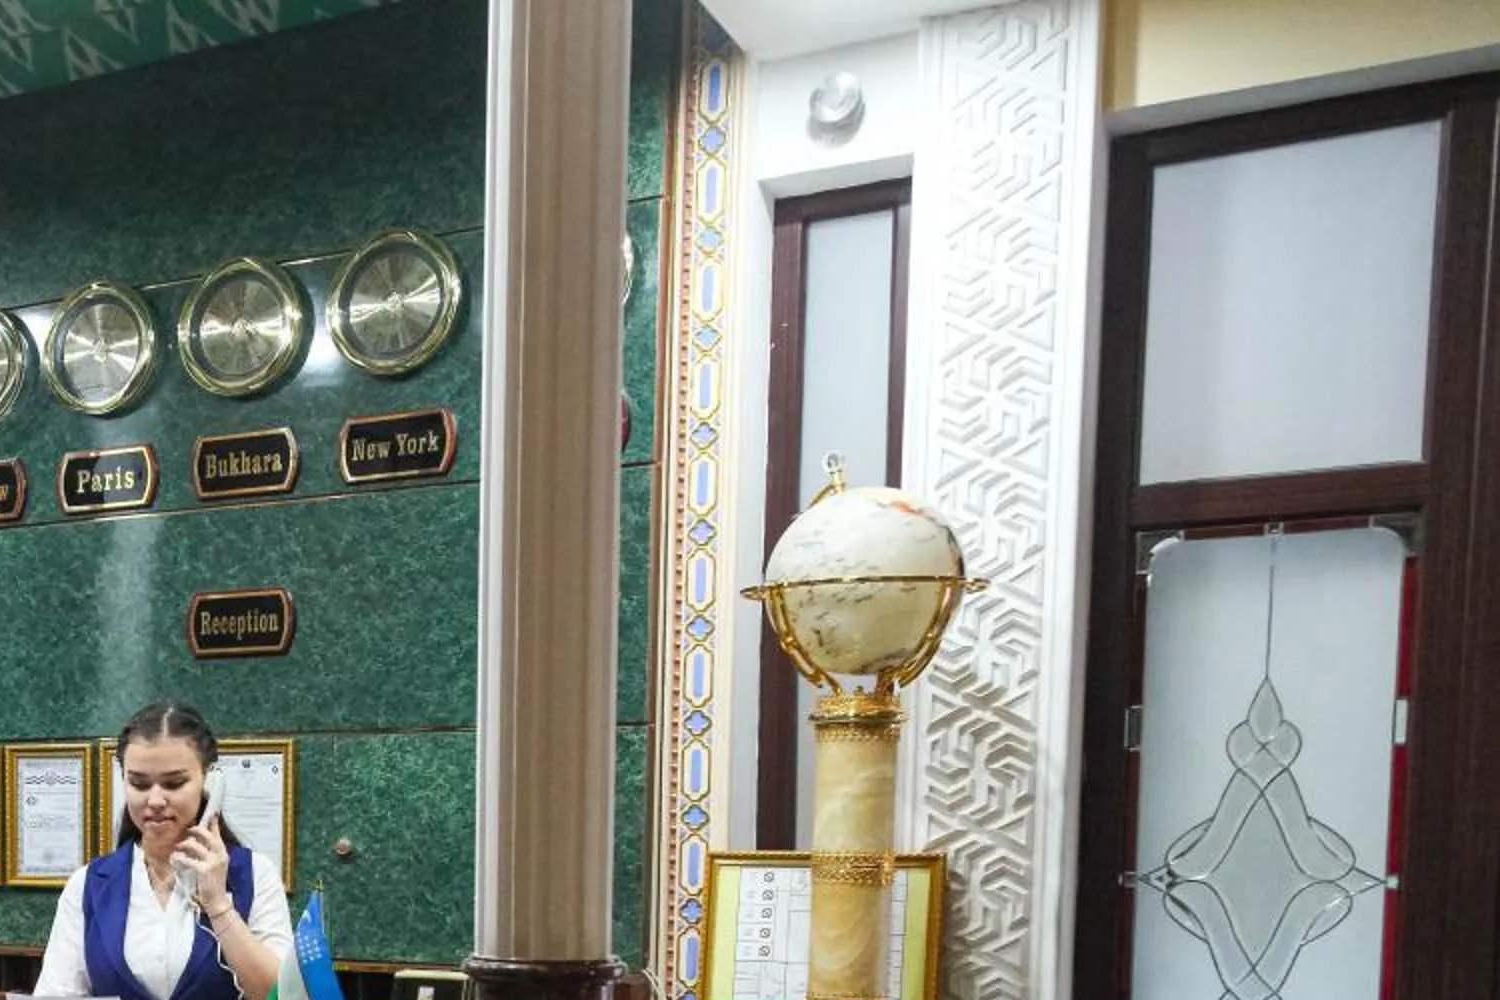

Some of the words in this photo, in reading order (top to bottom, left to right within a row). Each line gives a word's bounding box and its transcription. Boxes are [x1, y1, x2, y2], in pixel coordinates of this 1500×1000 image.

[351, 438, 391, 462] New
[394, 429, 441, 457] York
[76, 466, 135, 494] Paris
[204, 450, 284, 480] Bukhara
[200, 607, 279, 641] Reception
